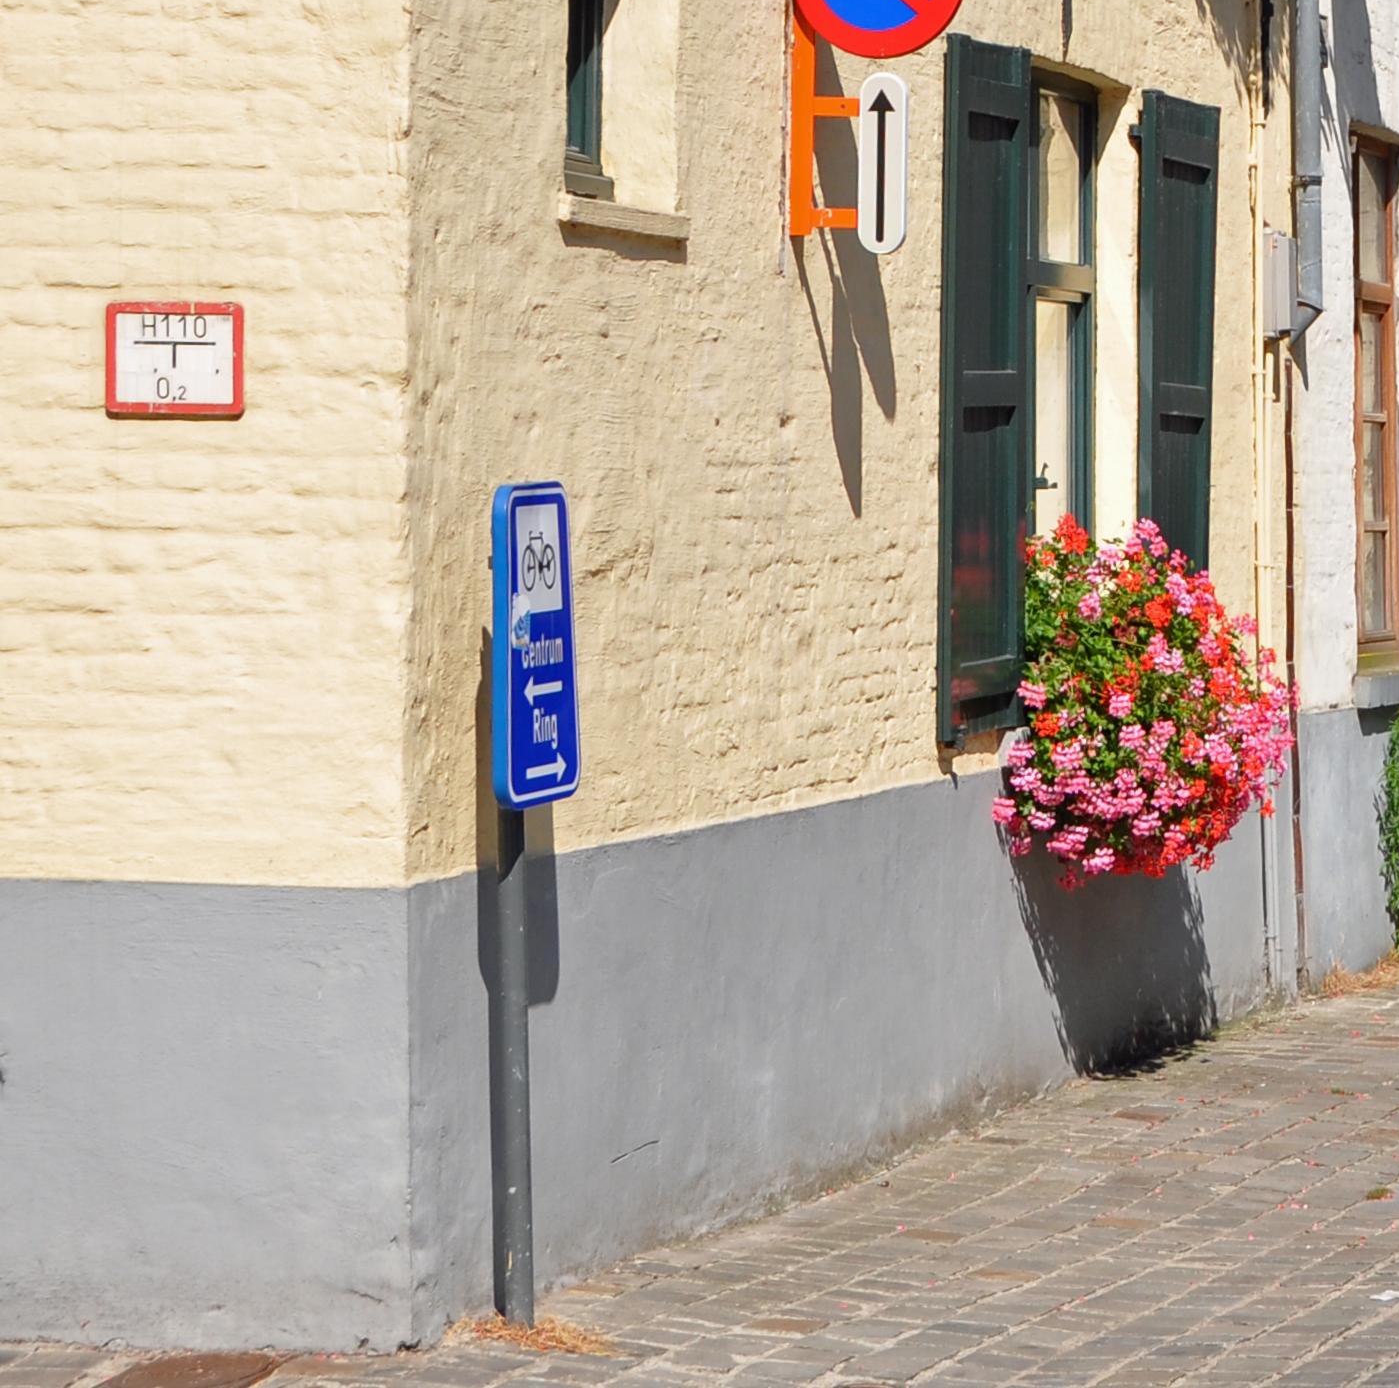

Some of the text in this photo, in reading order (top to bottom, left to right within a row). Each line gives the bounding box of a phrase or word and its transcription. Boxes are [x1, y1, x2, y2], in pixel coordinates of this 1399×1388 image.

[142, 314, 207, 338] H110
[521, 633, 564, 669] Centrum
[533, 708, 558, 750] Ring
